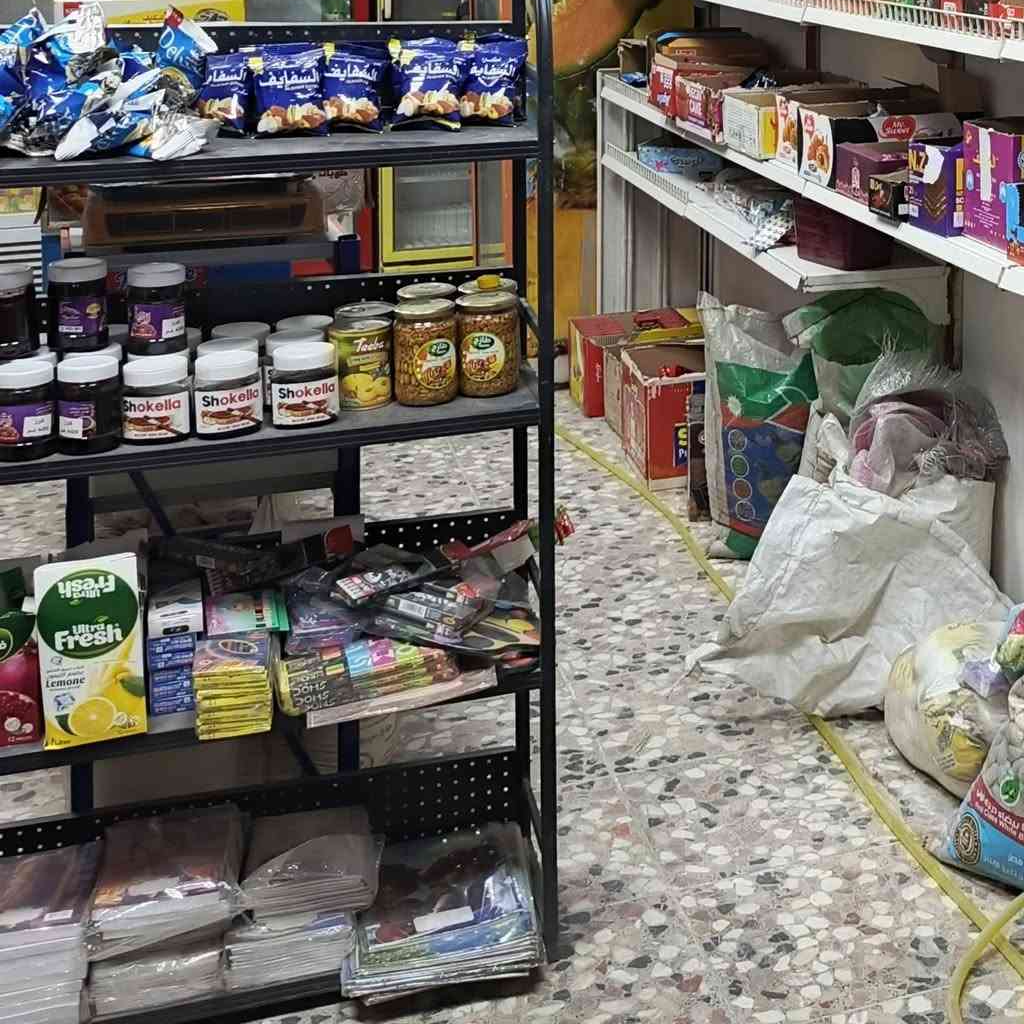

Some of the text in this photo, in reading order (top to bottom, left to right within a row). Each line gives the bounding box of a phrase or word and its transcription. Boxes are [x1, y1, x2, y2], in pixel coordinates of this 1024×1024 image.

[202, 387, 260, 408] Shokella
[277, 381, 335, 400] Shokella
[123, 397, 182, 413] Shokella
[57, 575, 116, 597] Fresh
[72, 622, 105, 634] Ultra
[54, 625, 123, 652] Fresh
